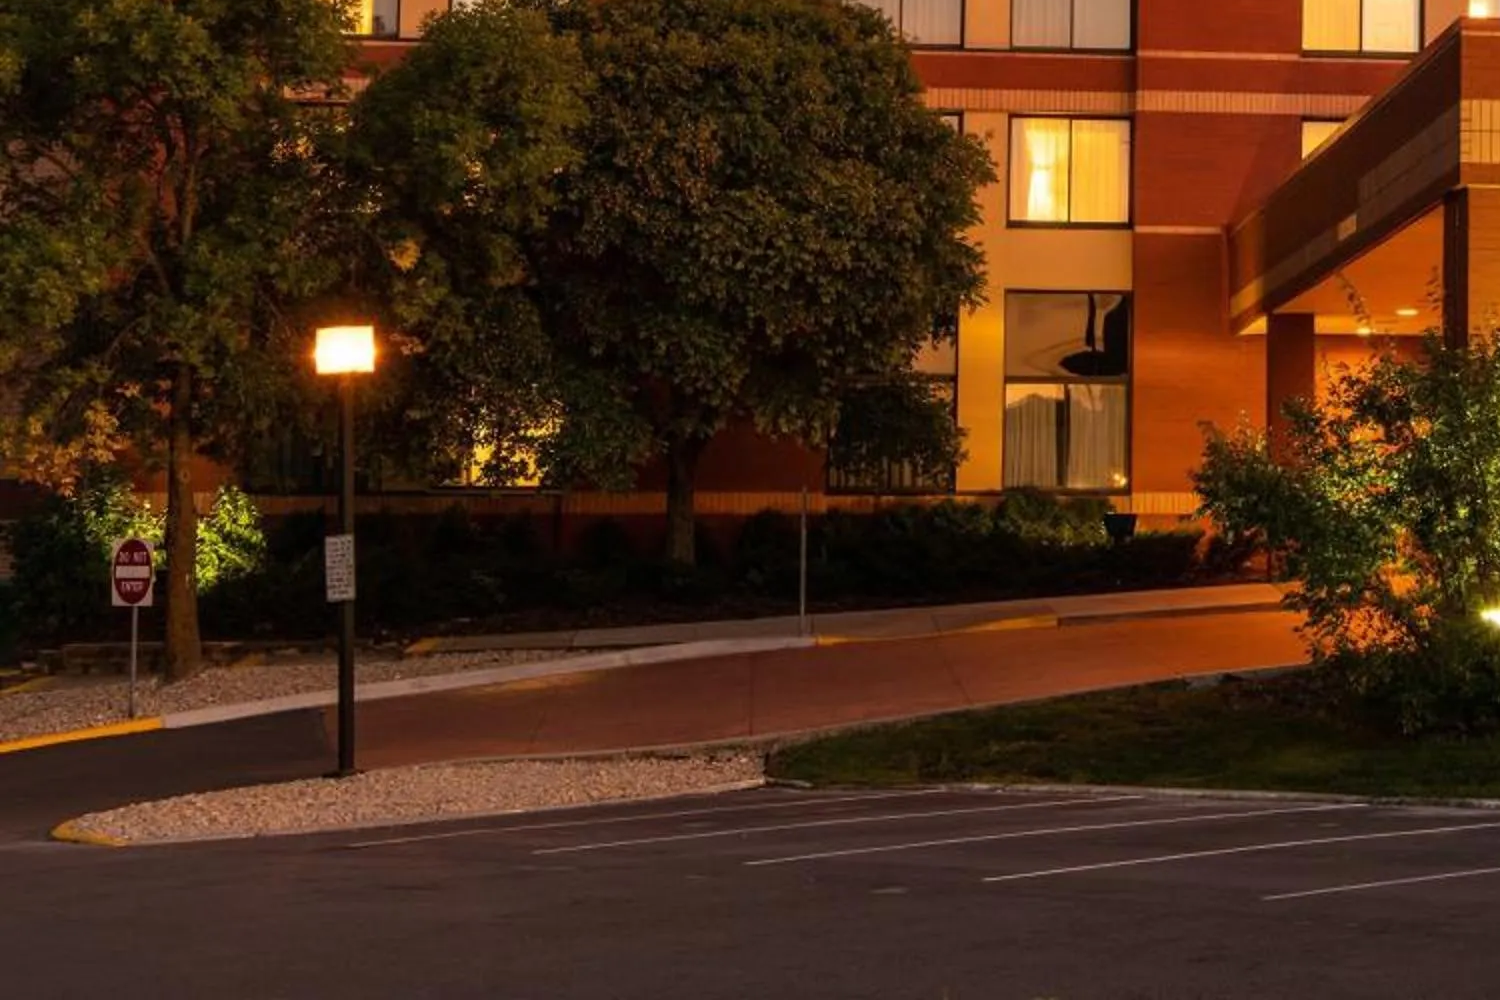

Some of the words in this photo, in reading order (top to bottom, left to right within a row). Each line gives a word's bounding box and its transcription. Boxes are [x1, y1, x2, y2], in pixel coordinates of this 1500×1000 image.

[118, 551, 131, 563] DO
[133, 551, 147, 564] NOT
[120, 580, 144, 592] ENTER
